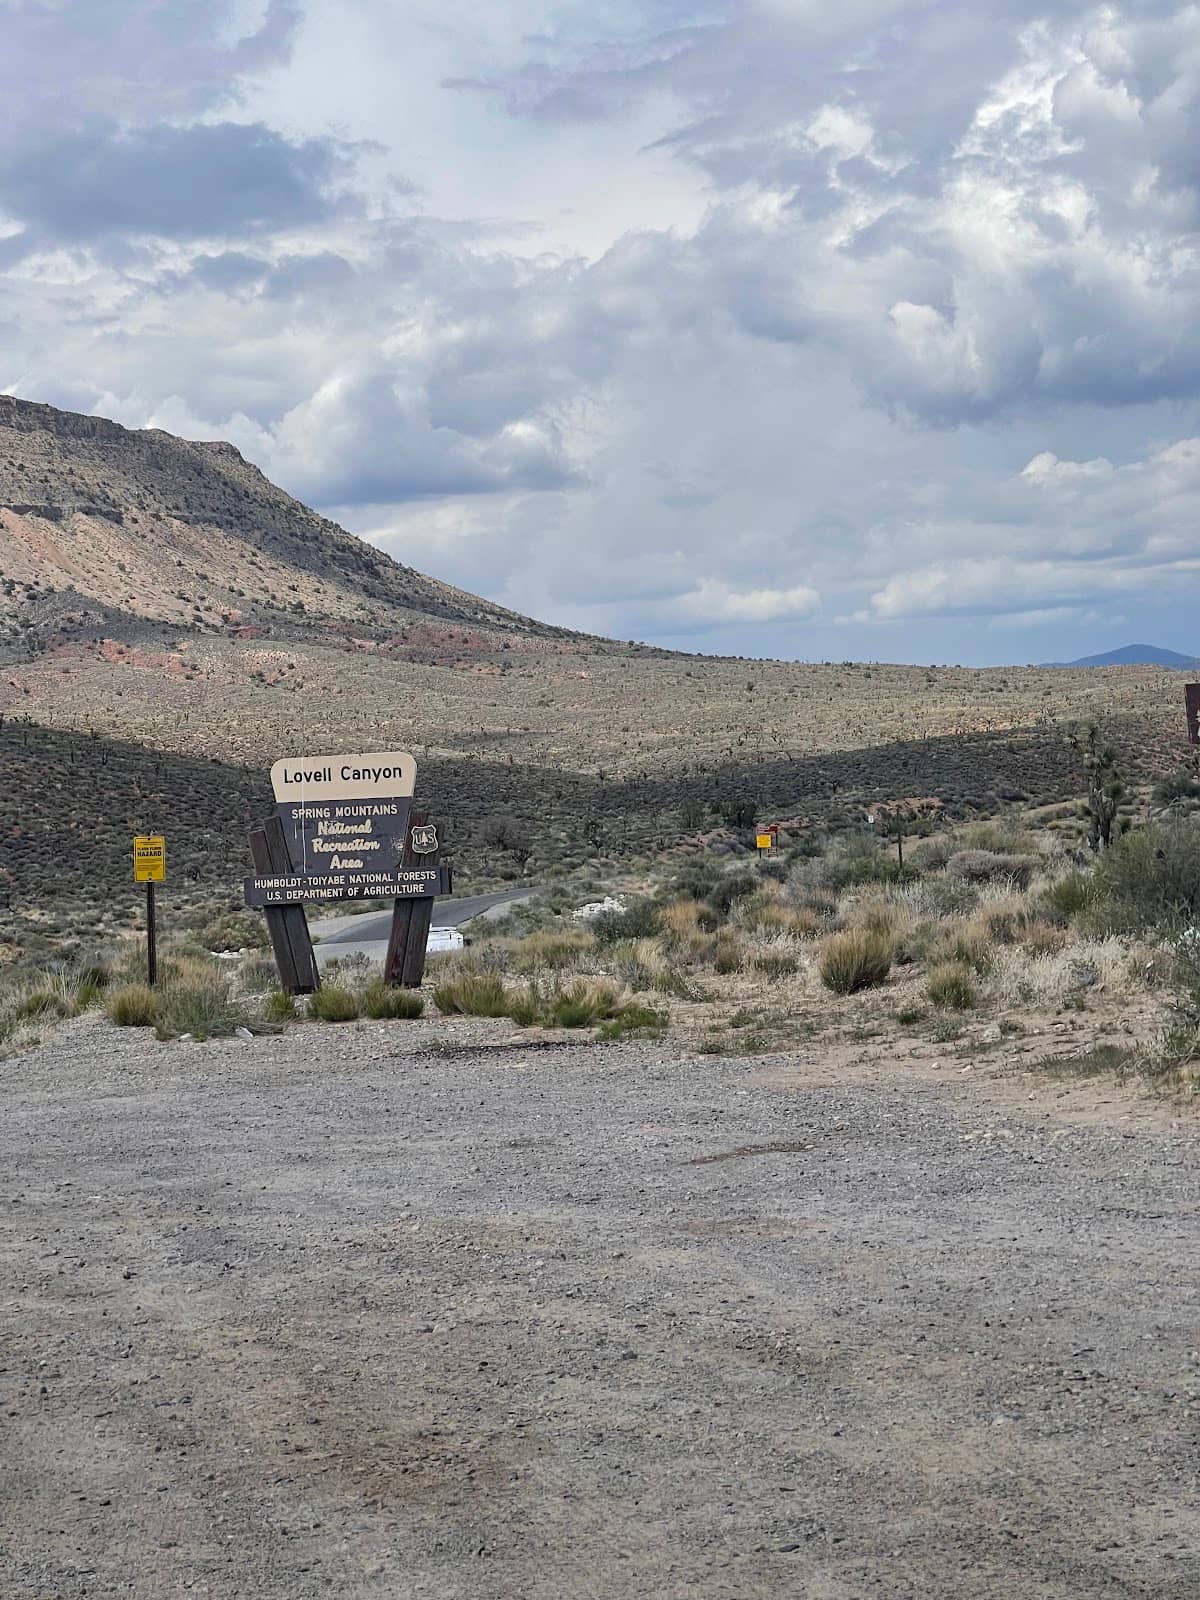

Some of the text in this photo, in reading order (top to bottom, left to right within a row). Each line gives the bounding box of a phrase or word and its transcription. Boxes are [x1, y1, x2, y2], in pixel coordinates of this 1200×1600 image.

[284, 766, 402, 783] Lovell Canyon
[291, 805, 398, 819] SPRING MOUNTAINS
[318, 819, 372, 835] National
[311, 838, 380, 852] Recreation
[330, 855, 363, 869] Area
[350, 873, 393, 884] NATIONAL
[397, 871, 436, 881] FORESTS
[267, 884, 425, 900] U.S. DEPARTMENT OF AGRICULTURE
